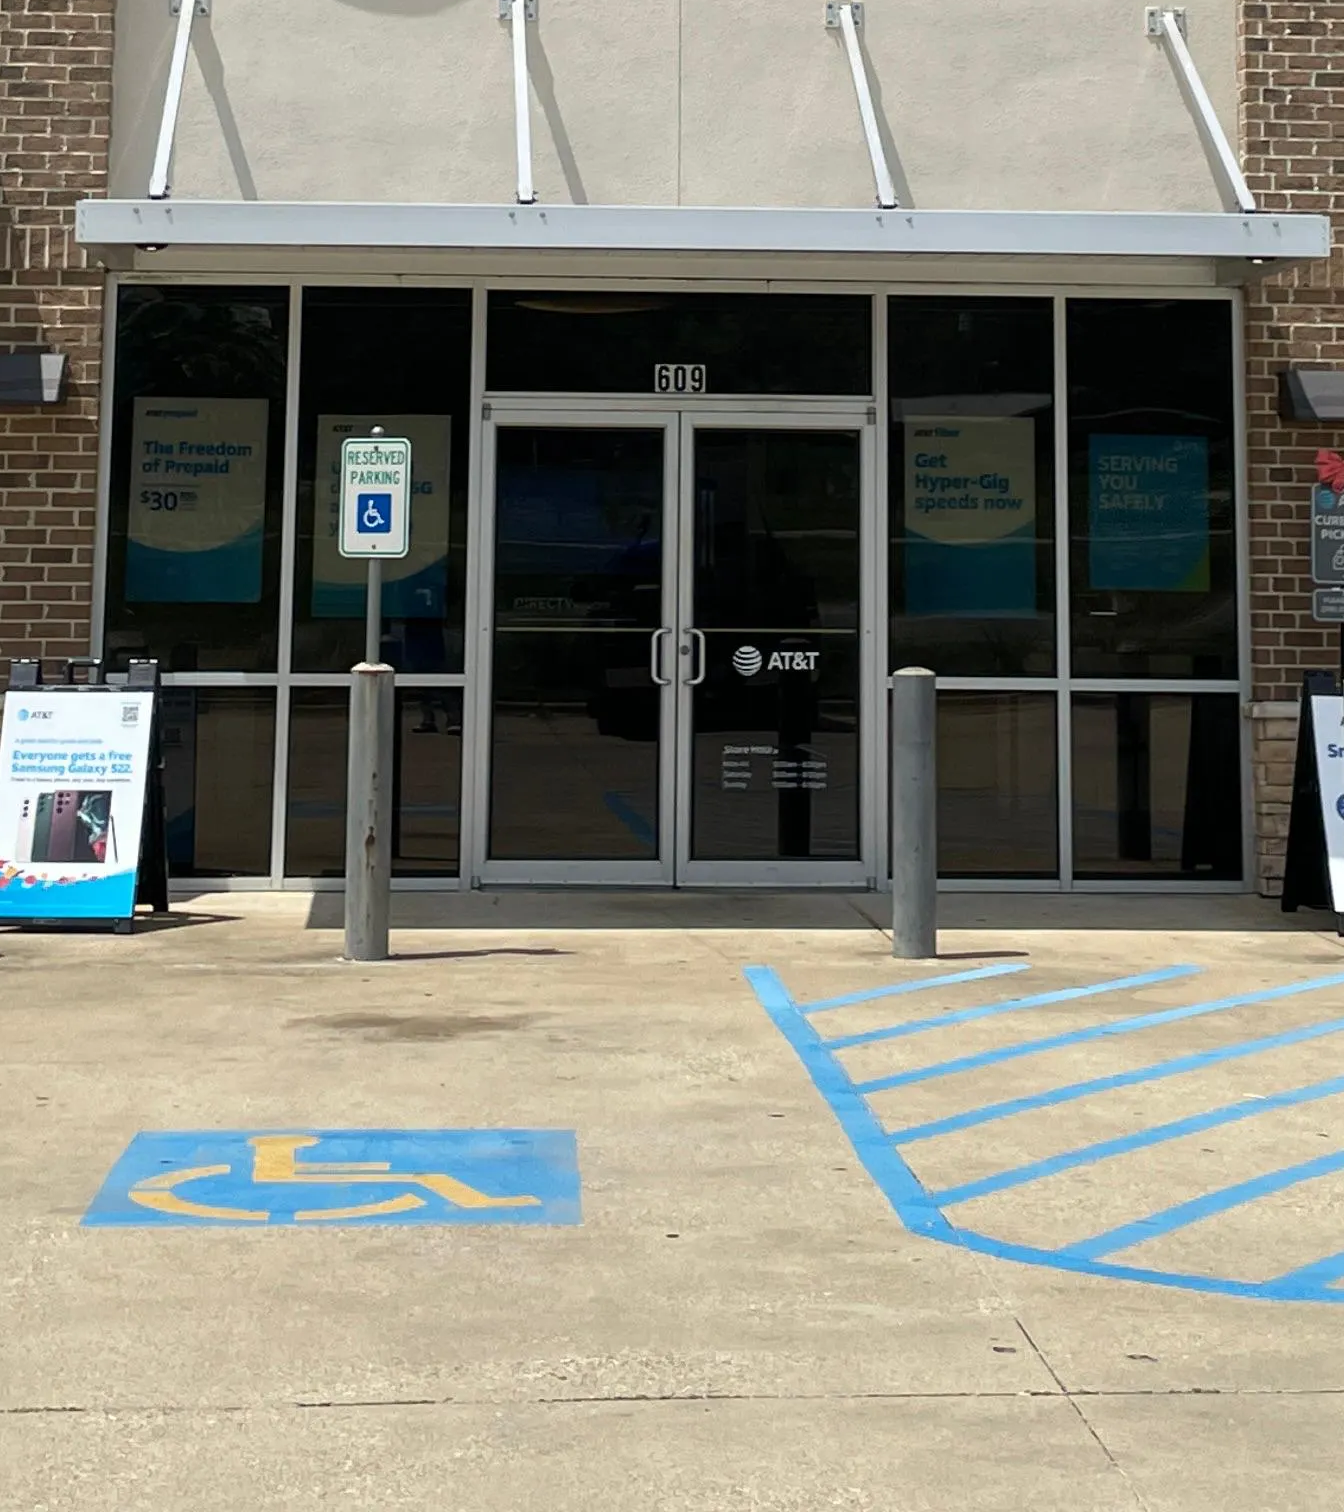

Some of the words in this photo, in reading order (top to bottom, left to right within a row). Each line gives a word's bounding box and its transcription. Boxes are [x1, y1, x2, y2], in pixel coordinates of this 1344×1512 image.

[658, 365, 703, 391] 609
[143, 441, 174, 455] The
[179, 441, 253, 456] Freedom
[347, 450, 405, 465] RESERVED
[915, 453, 948, 468] Get
[1097, 454, 1178, 473] SERVING
[142, 459, 161, 473] of
[165, 459, 229, 477] Prepaid
[350, 470, 401, 485] PARKING
[915, 473, 1010, 494] Hyper-Gig
[1098, 474, 1137, 491] YOU
[140, 490, 178, 511] $30
[915, 494, 978, 513] speeds
[983, 497, 1024, 510] now
[1098, 493, 1167, 510] SAFELY
[767, 651, 820, 671] AT&T
[30, 710, 54, 720] AT&T
[12, 750, 68, 763] Everyone
[71, 752, 96, 764] gets
[108, 750, 133, 761] free
[11, 763, 65, 776] Samsung
[68, 763, 108, 776] Galaxy
